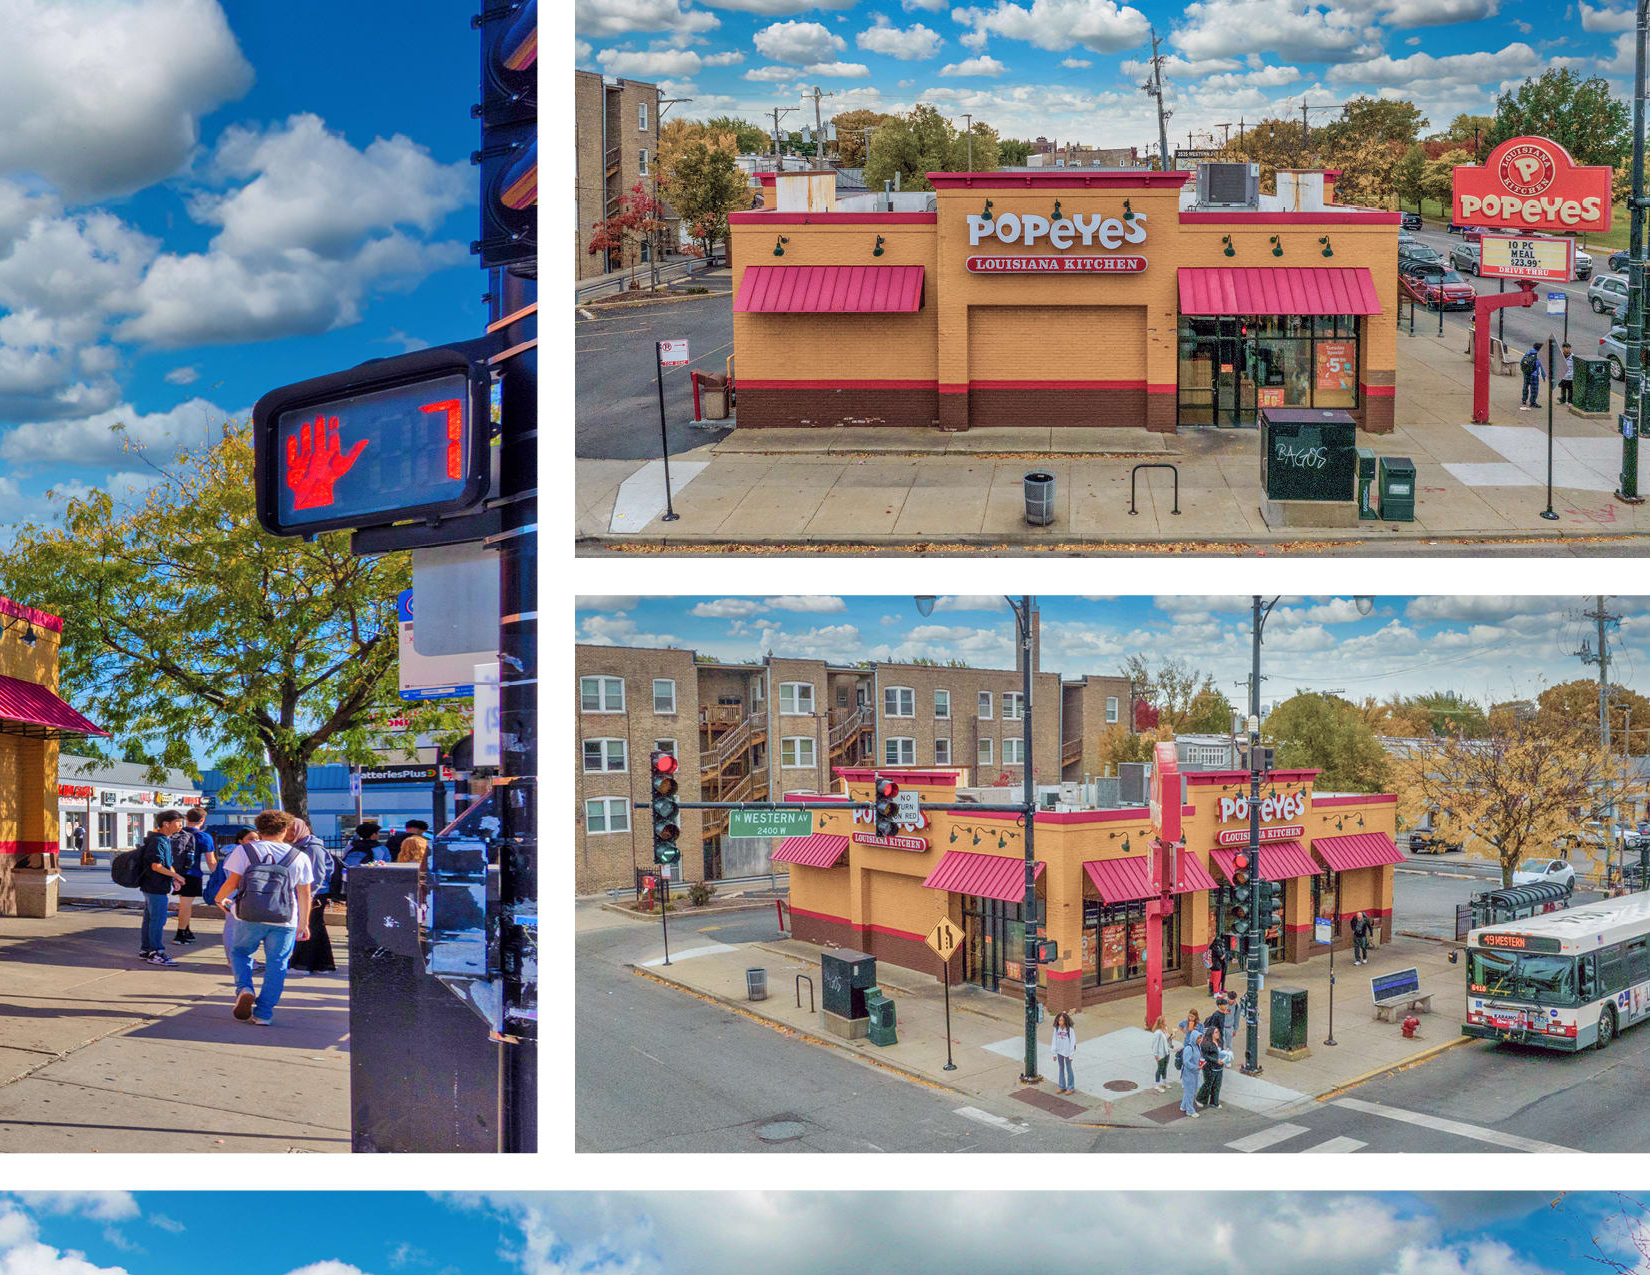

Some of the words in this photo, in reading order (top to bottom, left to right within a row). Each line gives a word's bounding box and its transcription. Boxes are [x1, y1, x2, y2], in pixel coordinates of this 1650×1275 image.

[1502, 147, 1550, 168] LOUISIANA
[1504, 178, 1550, 194] KITCHEN
[1511, 250, 1535, 258] MEAL
[976, 258, 1058, 270] LOUISIANA
[1064, 258, 1138, 270] KITCHEN
[1499, 266, 1524, 274] DRIVE
[1526, 268, 1549, 276] THRU
[361, 769, 427, 779] atteriesPlus
[744, 813, 795, 823] WESTERN
[1268, 828, 1301, 838] KITCHEN
[890, 838, 921, 849] KITCHEN
[1496, 936, 1526, 948] WESTERN
